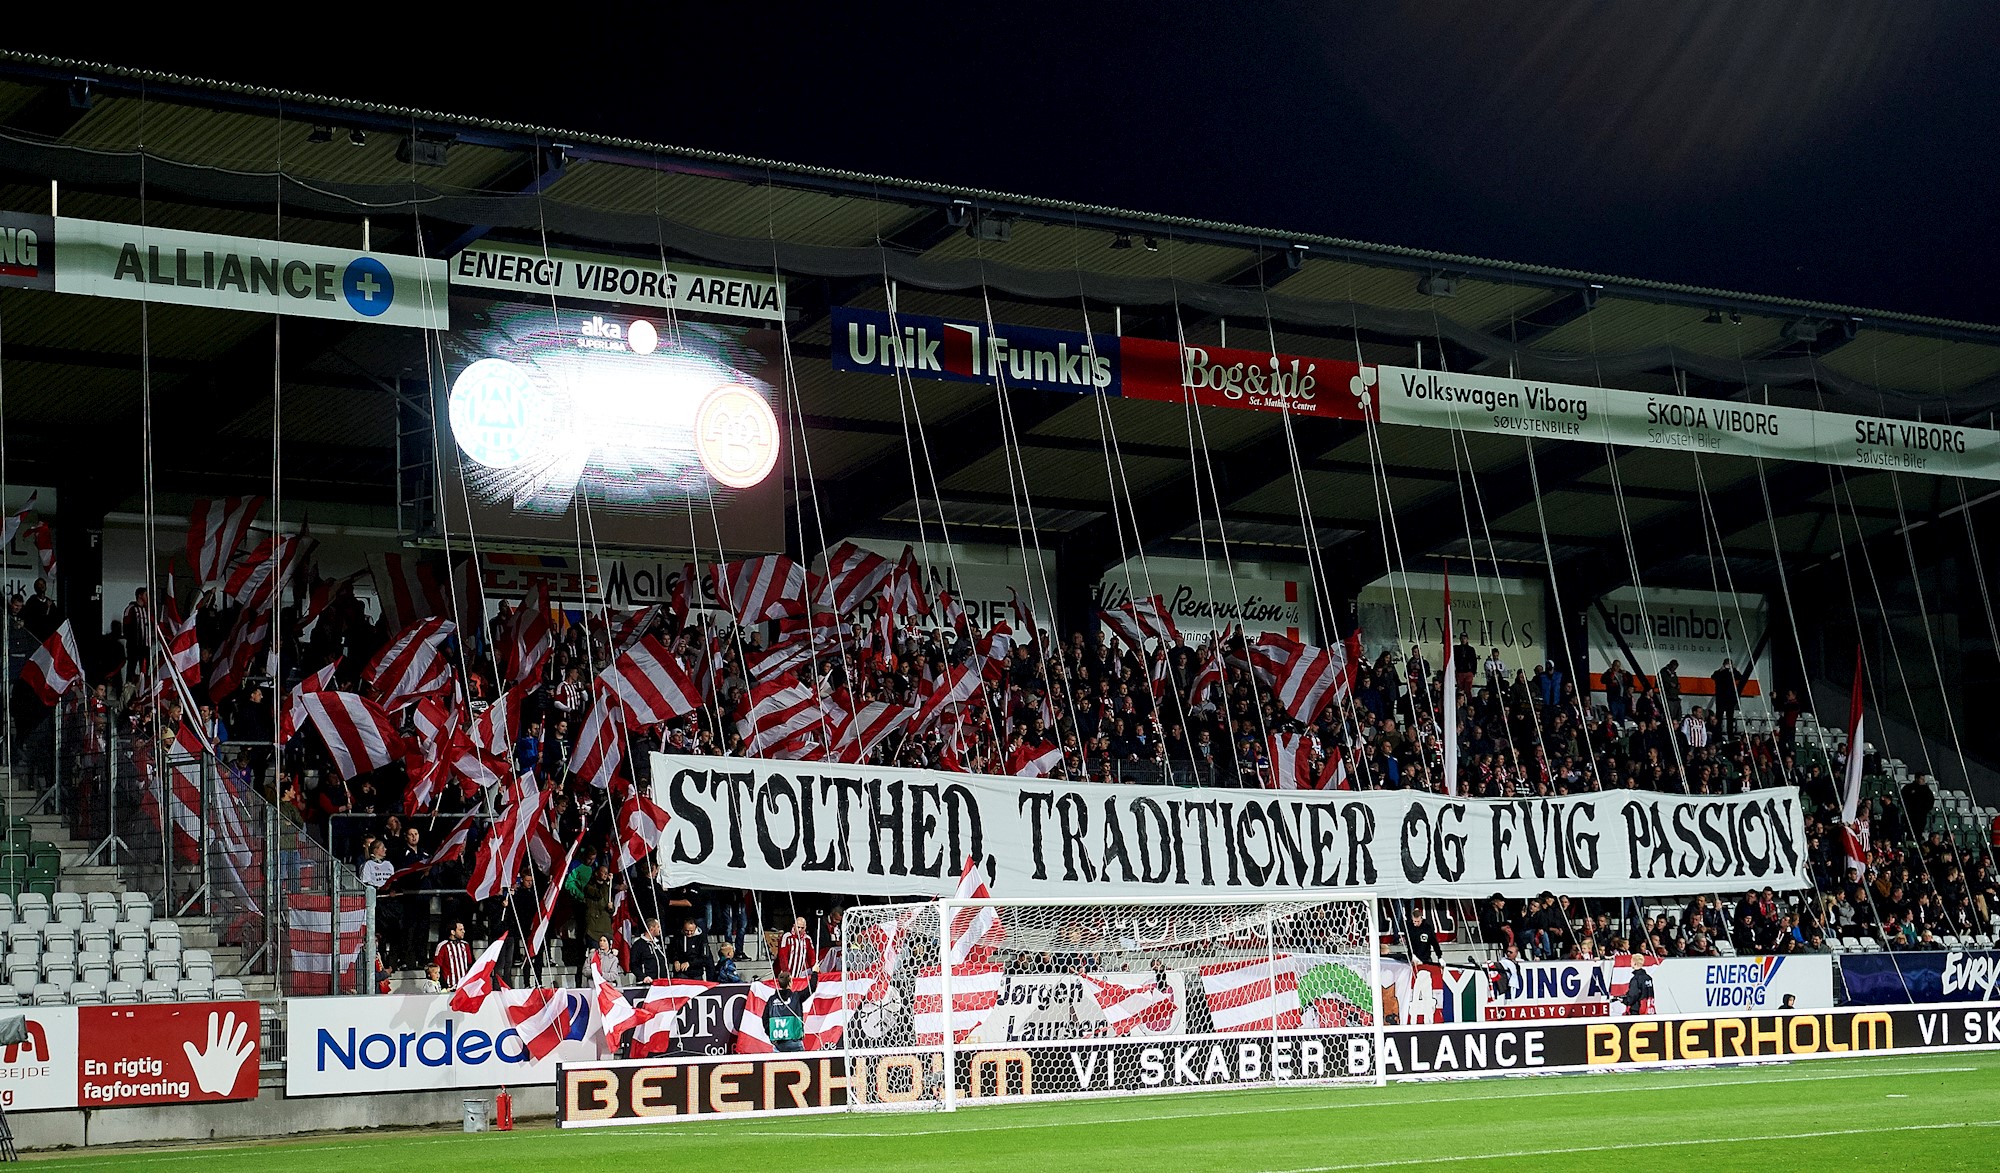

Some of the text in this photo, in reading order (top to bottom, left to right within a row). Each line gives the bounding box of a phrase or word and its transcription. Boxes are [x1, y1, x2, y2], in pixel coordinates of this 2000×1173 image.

[114, 243, 337, 301] ALLIANCE
[458, 250, 780, 312] ENERGI VIBORG ARENA
[581, 316, 621, 339] alka
[848, 322, 1111, 388] Unik Funkis
[1182, 347, 1316, 400] Bog&idé
[1292, 400, 1317, 411] Centret
[1400, 373, 1588, 421] Volkswagen Viborg
[1493, 415, 1580, 436] SØLVSTENBILER
[1647, 396, 1778, 436] ŠKODA VIBORG
[1648, 428, 1721, 449] Sølvsten Biler
[1855, 420, 1965, 454] SEAT VIBORG
[1856, 448, 1927, 470] Sølvsten Biler
[1169, 584, 1284, 622] Renovation
[1408, 616, 1534, 649] MYTHOS
[1605, 604, 1733, 641] domainbox
[669, 769, 1799, 888] STOLTHED, TRADITIONER OG EVIG PASSION
[1494, 967, 1581, 999] DING
[1706, 963, 1764, 985] ENERGI
[1941, 952, 2000, 1001] EVRY
[996, 977, 1085, 1010] Jørgen
[1705, 985, 1766, 1007] VIBORG
[772, 1029, 789, 1039] 084
[775, 1019, 787, 1028] TV
[318, 1019, 530, 1072] Nordea
[704, 1043, 728, 1056] Cool
[84, 1056, 163, 1077] En rigtig
[566, 1047, 1032, 1119] BEIERHOLM
[1071, 1050, 1116, 1089] VI
[1140, 1038, 1325, 1087] SKABER
[1346, 1030, 1546, 1075] BALANCE
[1586, 1010, 1894, 1065] BEIERHOLM
[1917, 1012, 1949, 1046] VI
[83, 1079, 191, 1104] fagforening
